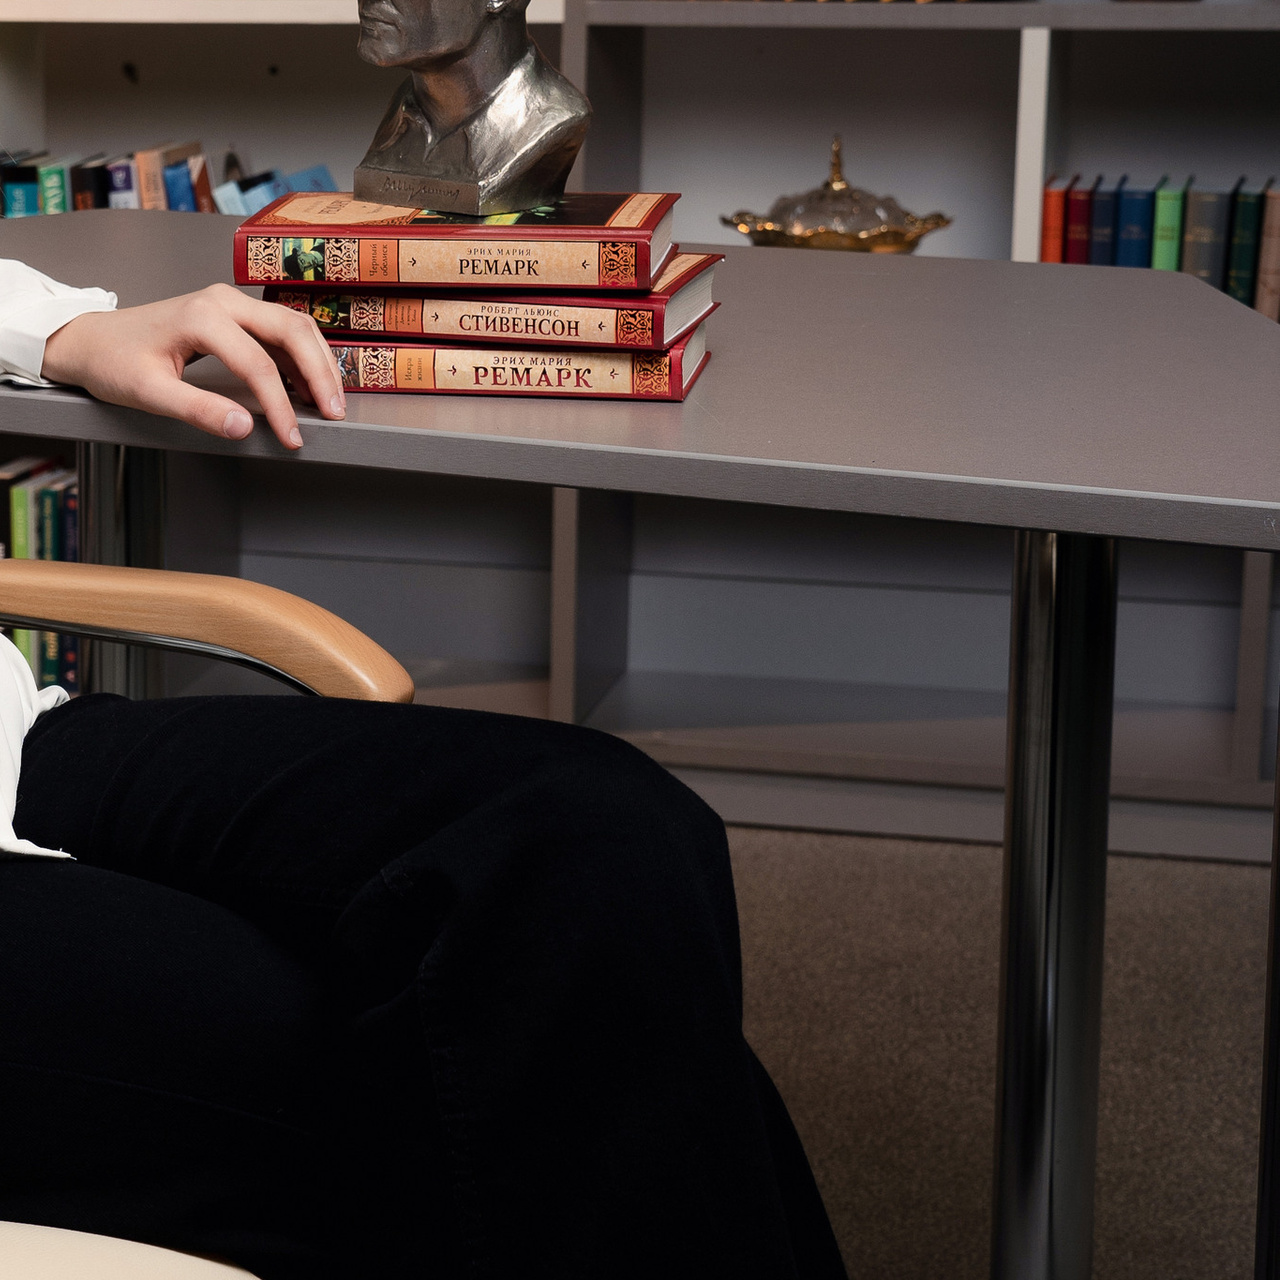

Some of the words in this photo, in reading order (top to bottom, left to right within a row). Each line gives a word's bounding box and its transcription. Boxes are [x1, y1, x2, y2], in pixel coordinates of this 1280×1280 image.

[370, 243, 379, 277] Черный
[380, 244, 388, 277] обелиск
[467, 247, 493, 256] ЭРИХ
[497, 247, 531, 257] МАРИЯ
[458, 258, 539, 276] РЕМАРК
[481, 305, 521, 315] РОБЕРТ
[523, 307, 560, 318] ЛЬЮИС
[458, 314, 580, 337] СТИВЕНСОН
[404, 357, 412, 381] Искра
[493, 356, 525, 366] ЭРИХ
[530, 356, 572, 367] МАРИЯ
[473, 365, 593, 388] РЕМАРК
